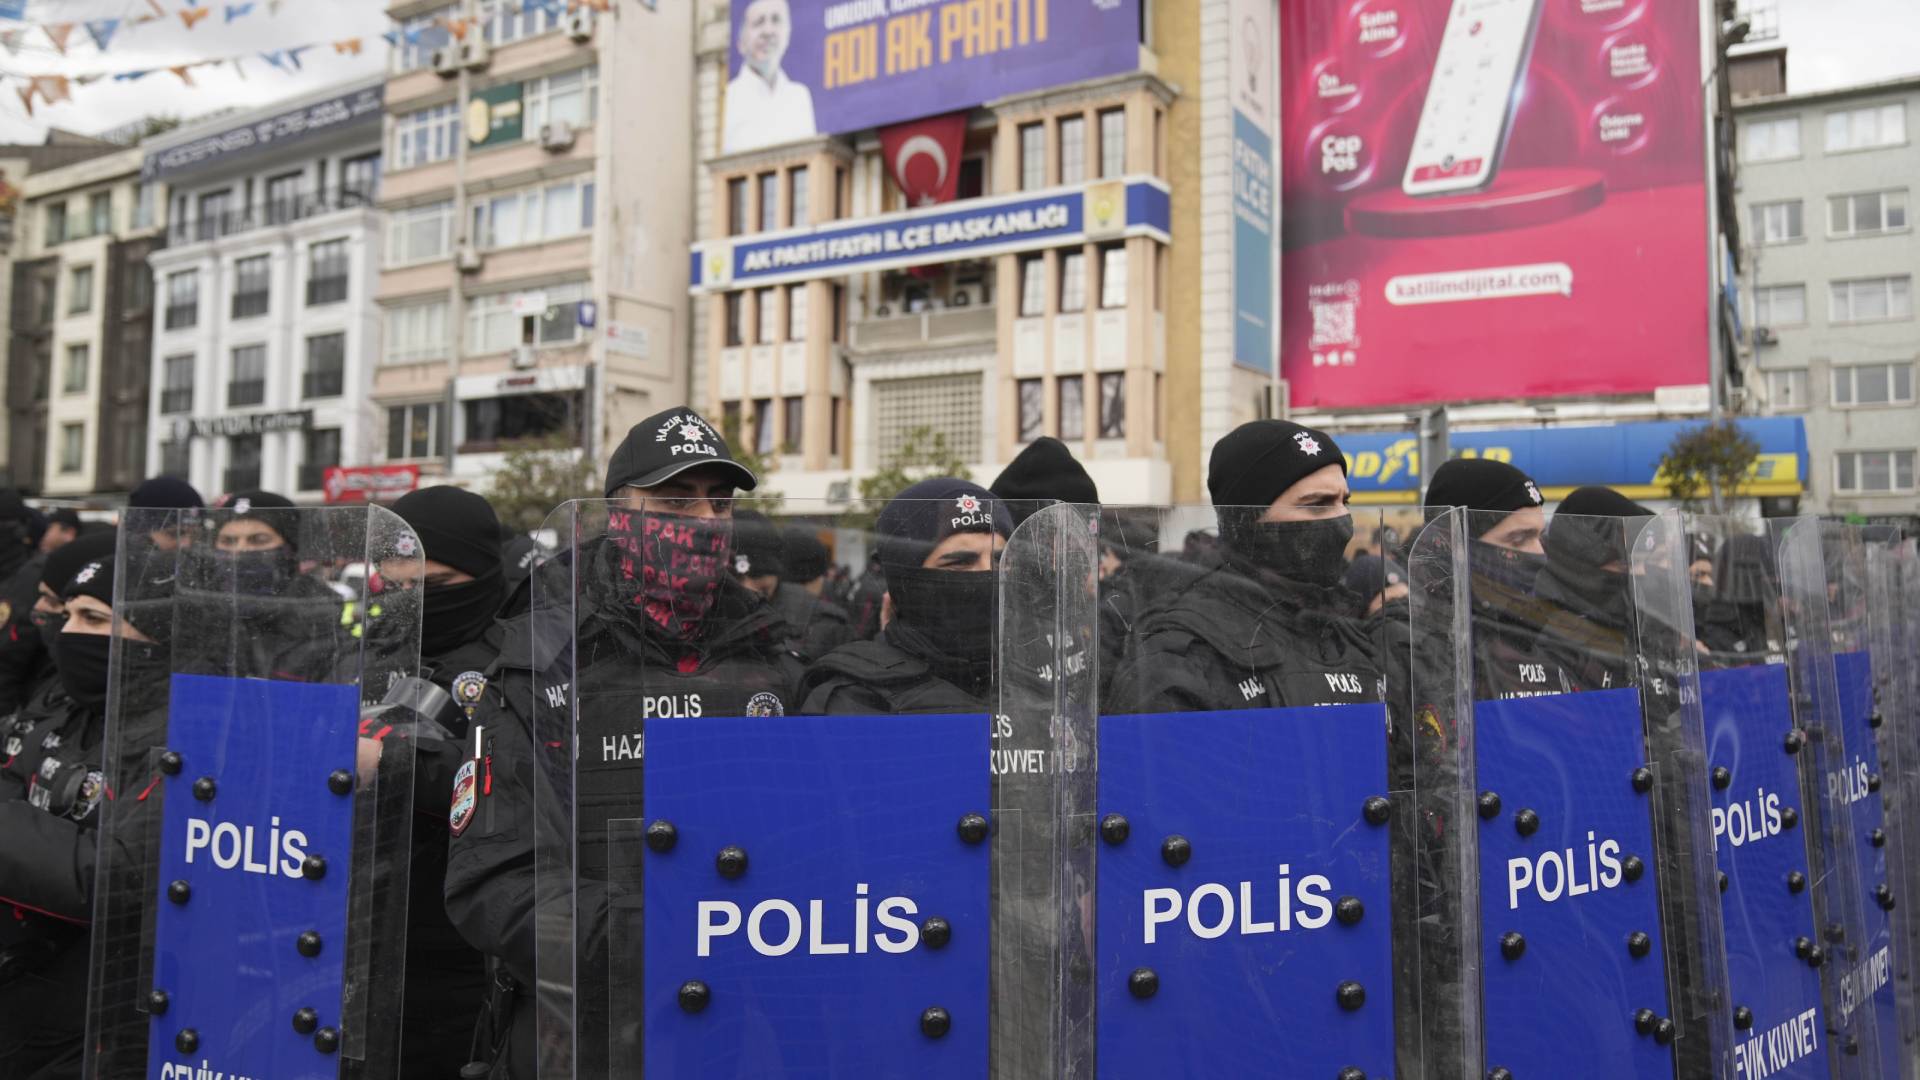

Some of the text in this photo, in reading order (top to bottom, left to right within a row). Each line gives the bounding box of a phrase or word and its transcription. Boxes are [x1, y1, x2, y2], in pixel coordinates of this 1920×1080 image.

[824, 24, 878, 89] ADI
[886, 11, 932, 75] AK
[1321, 135, 1361, 155] Cep
[1322, 153, 1357, 173] Pos
[743, 249, 772, 272] AK
[656, 415, 683, 442] HAZIR
[644, 517, 697, 549] PAK
[1508, 830, 1622, 910] POLİS
[697, 883, 920, 957] POLİS
[1143, 863, 1333, 944] POLİS
[1767, 1008, 1817, 1074] KUVVET
